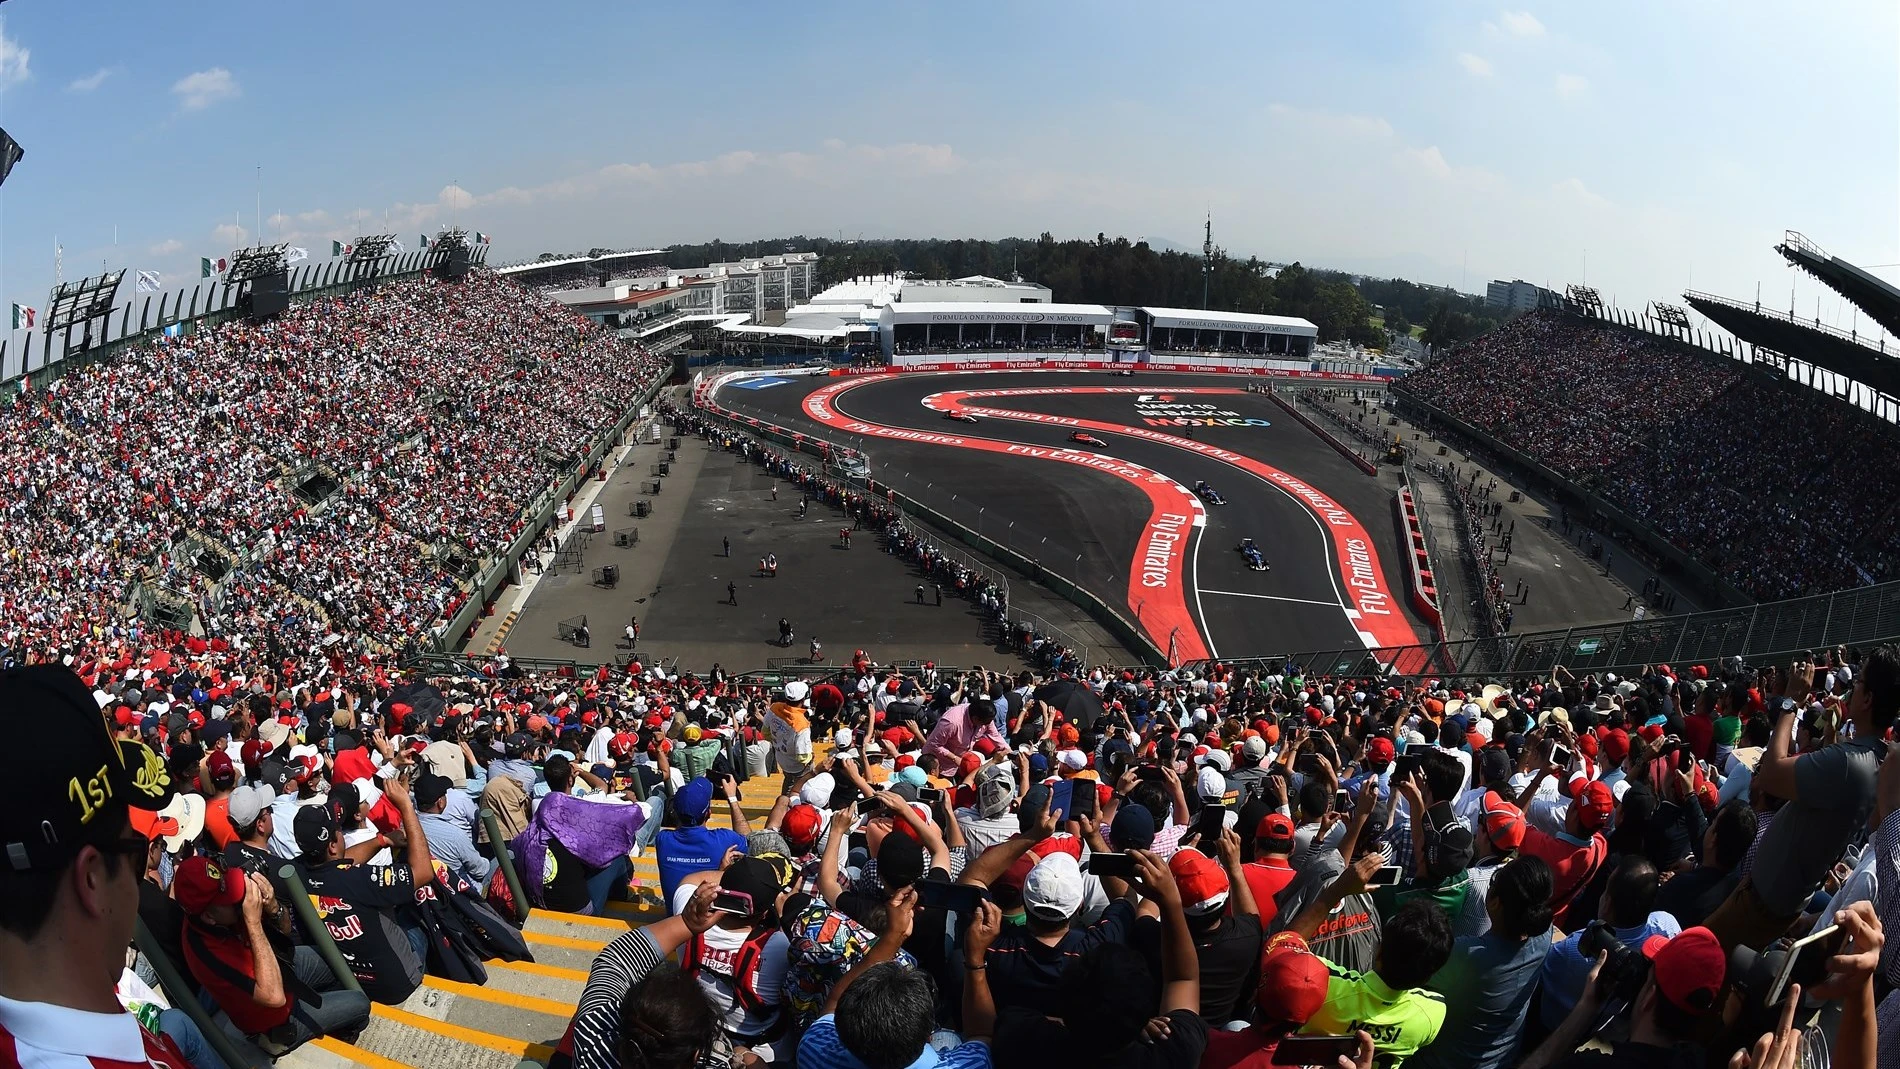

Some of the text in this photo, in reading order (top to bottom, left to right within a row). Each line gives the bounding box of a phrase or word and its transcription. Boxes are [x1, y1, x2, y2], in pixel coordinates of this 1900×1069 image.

[1000, 388, 1072, 396] Emirates
[962, 406, 1080, 426] Fly Emirates
[844, 422, 964, 446] Fly Emirates
[1124, 426, 1241, 463] Fly Emirates
[1006, 444, 1140, 478] Fly Emirates
[1268, 472, 1353, 526] Fly Emirates
[1142, 513, 1187, 588] Fly Emirates
[1345, 538, 1390, 614] Fly Emirates
[68, 764, 112, 824] 1ST
[325, 914, 363, 940] Bull
[1312, 912, 1369, 937] dafone
[705, 958, 733, 973] IBIZA
[1346, 1019, 1402, 1043] MESSI
